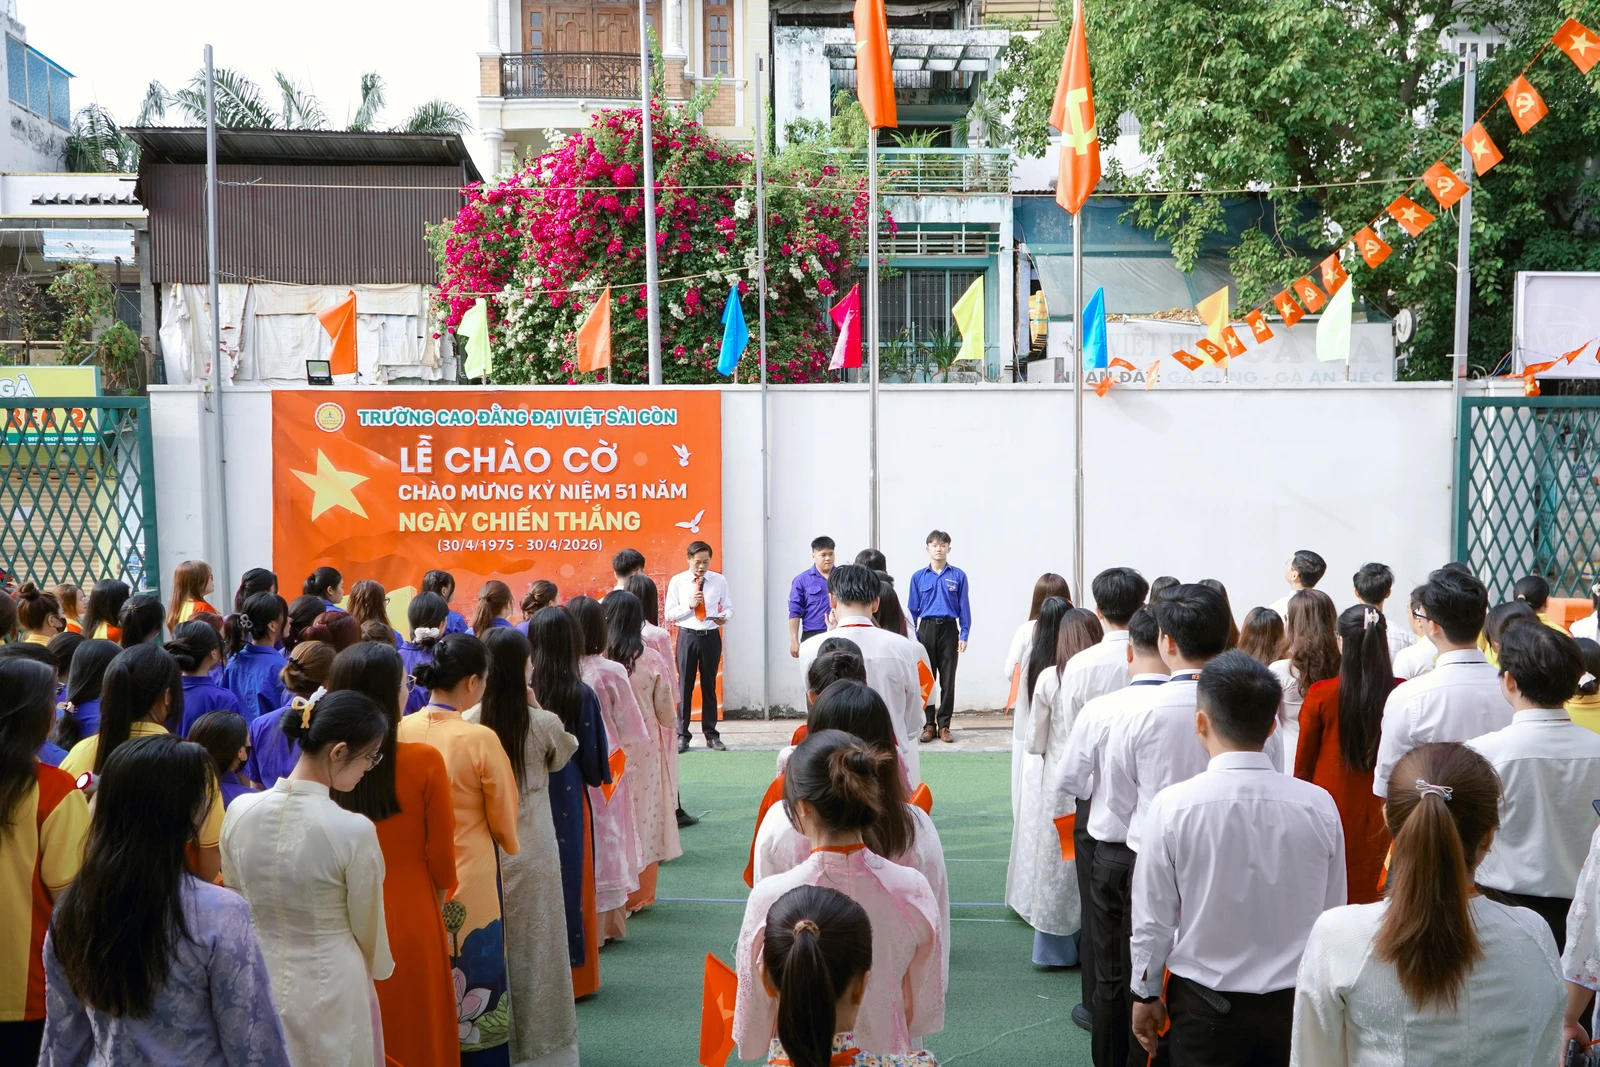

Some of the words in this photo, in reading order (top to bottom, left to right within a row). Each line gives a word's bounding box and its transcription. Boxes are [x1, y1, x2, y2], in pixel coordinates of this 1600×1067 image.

[358, 406, 434, 426] TRƯỜNG
[437, 409, 475, 426] CAO
[477, 403, 528, 426] ĐẲNG
[531, 409, 562, 429] ĐẠI
[564, 406, 604, 429] VIỆT
[605, 406, 636, 426] SÀI
[638, 406, 677, 426] GÒN
[400, 434, 432, 473] LỄ
[444, 439, 551, 474] CHÀO
[562, 438, 618, 473] CỜ
[398, 480, 456, 500] CHÀO
[461, 480, 524, 500] MỪNG
[528, 479, 556, 500] KỶ
[560, 480, 610, 504] NIỆM
[615, 484, 637, 500] 51
[642, 479, 687, 499] NĂM
[399, 507, 467, 532] NGÀY
[472, 505, 549, 532] CHIẾN
[554, 504, 641, 531] THẮNG
[437, 539, 514, 555] (30/4/1975
[526, 538, 603, 552] 30/4/2026)
